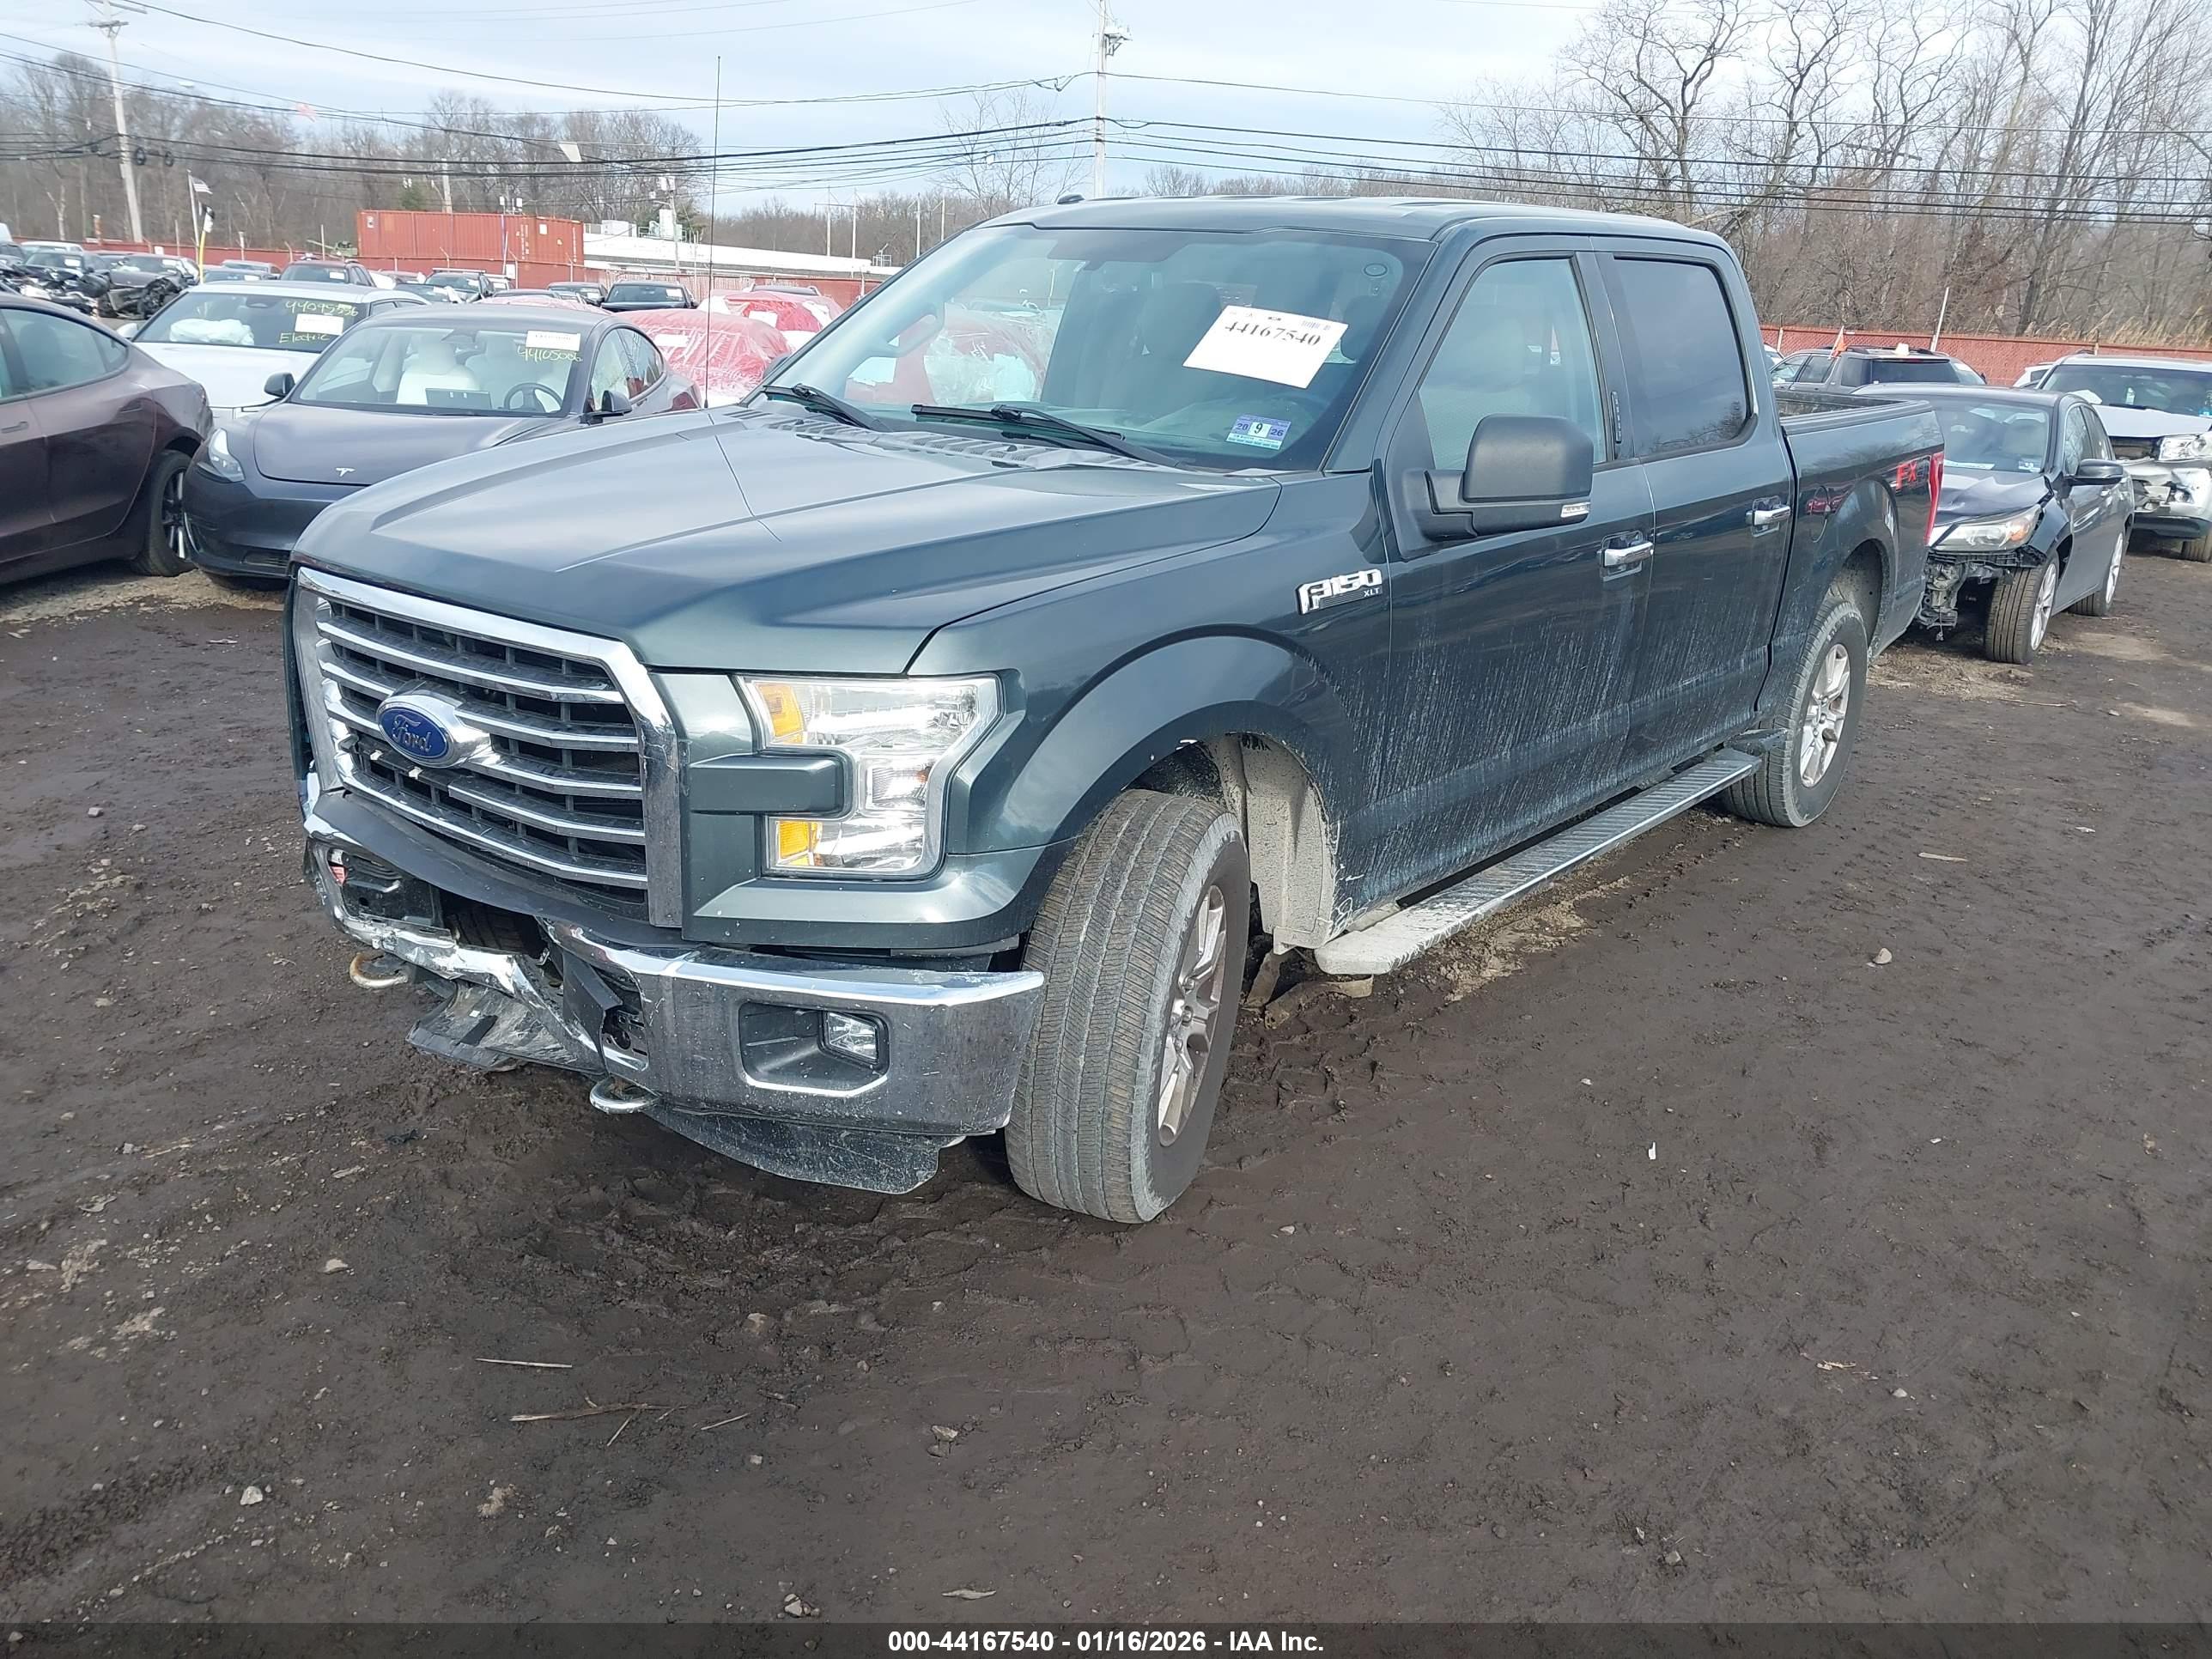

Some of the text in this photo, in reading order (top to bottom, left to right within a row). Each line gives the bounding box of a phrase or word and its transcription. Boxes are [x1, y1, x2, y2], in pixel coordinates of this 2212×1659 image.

[1225, 321, 1322, 346] 44167540
[1254, 422, 1263, 434] 9
[1364, 587, 1380, 598] XLT
[392, 714, 432, 753] Ford
